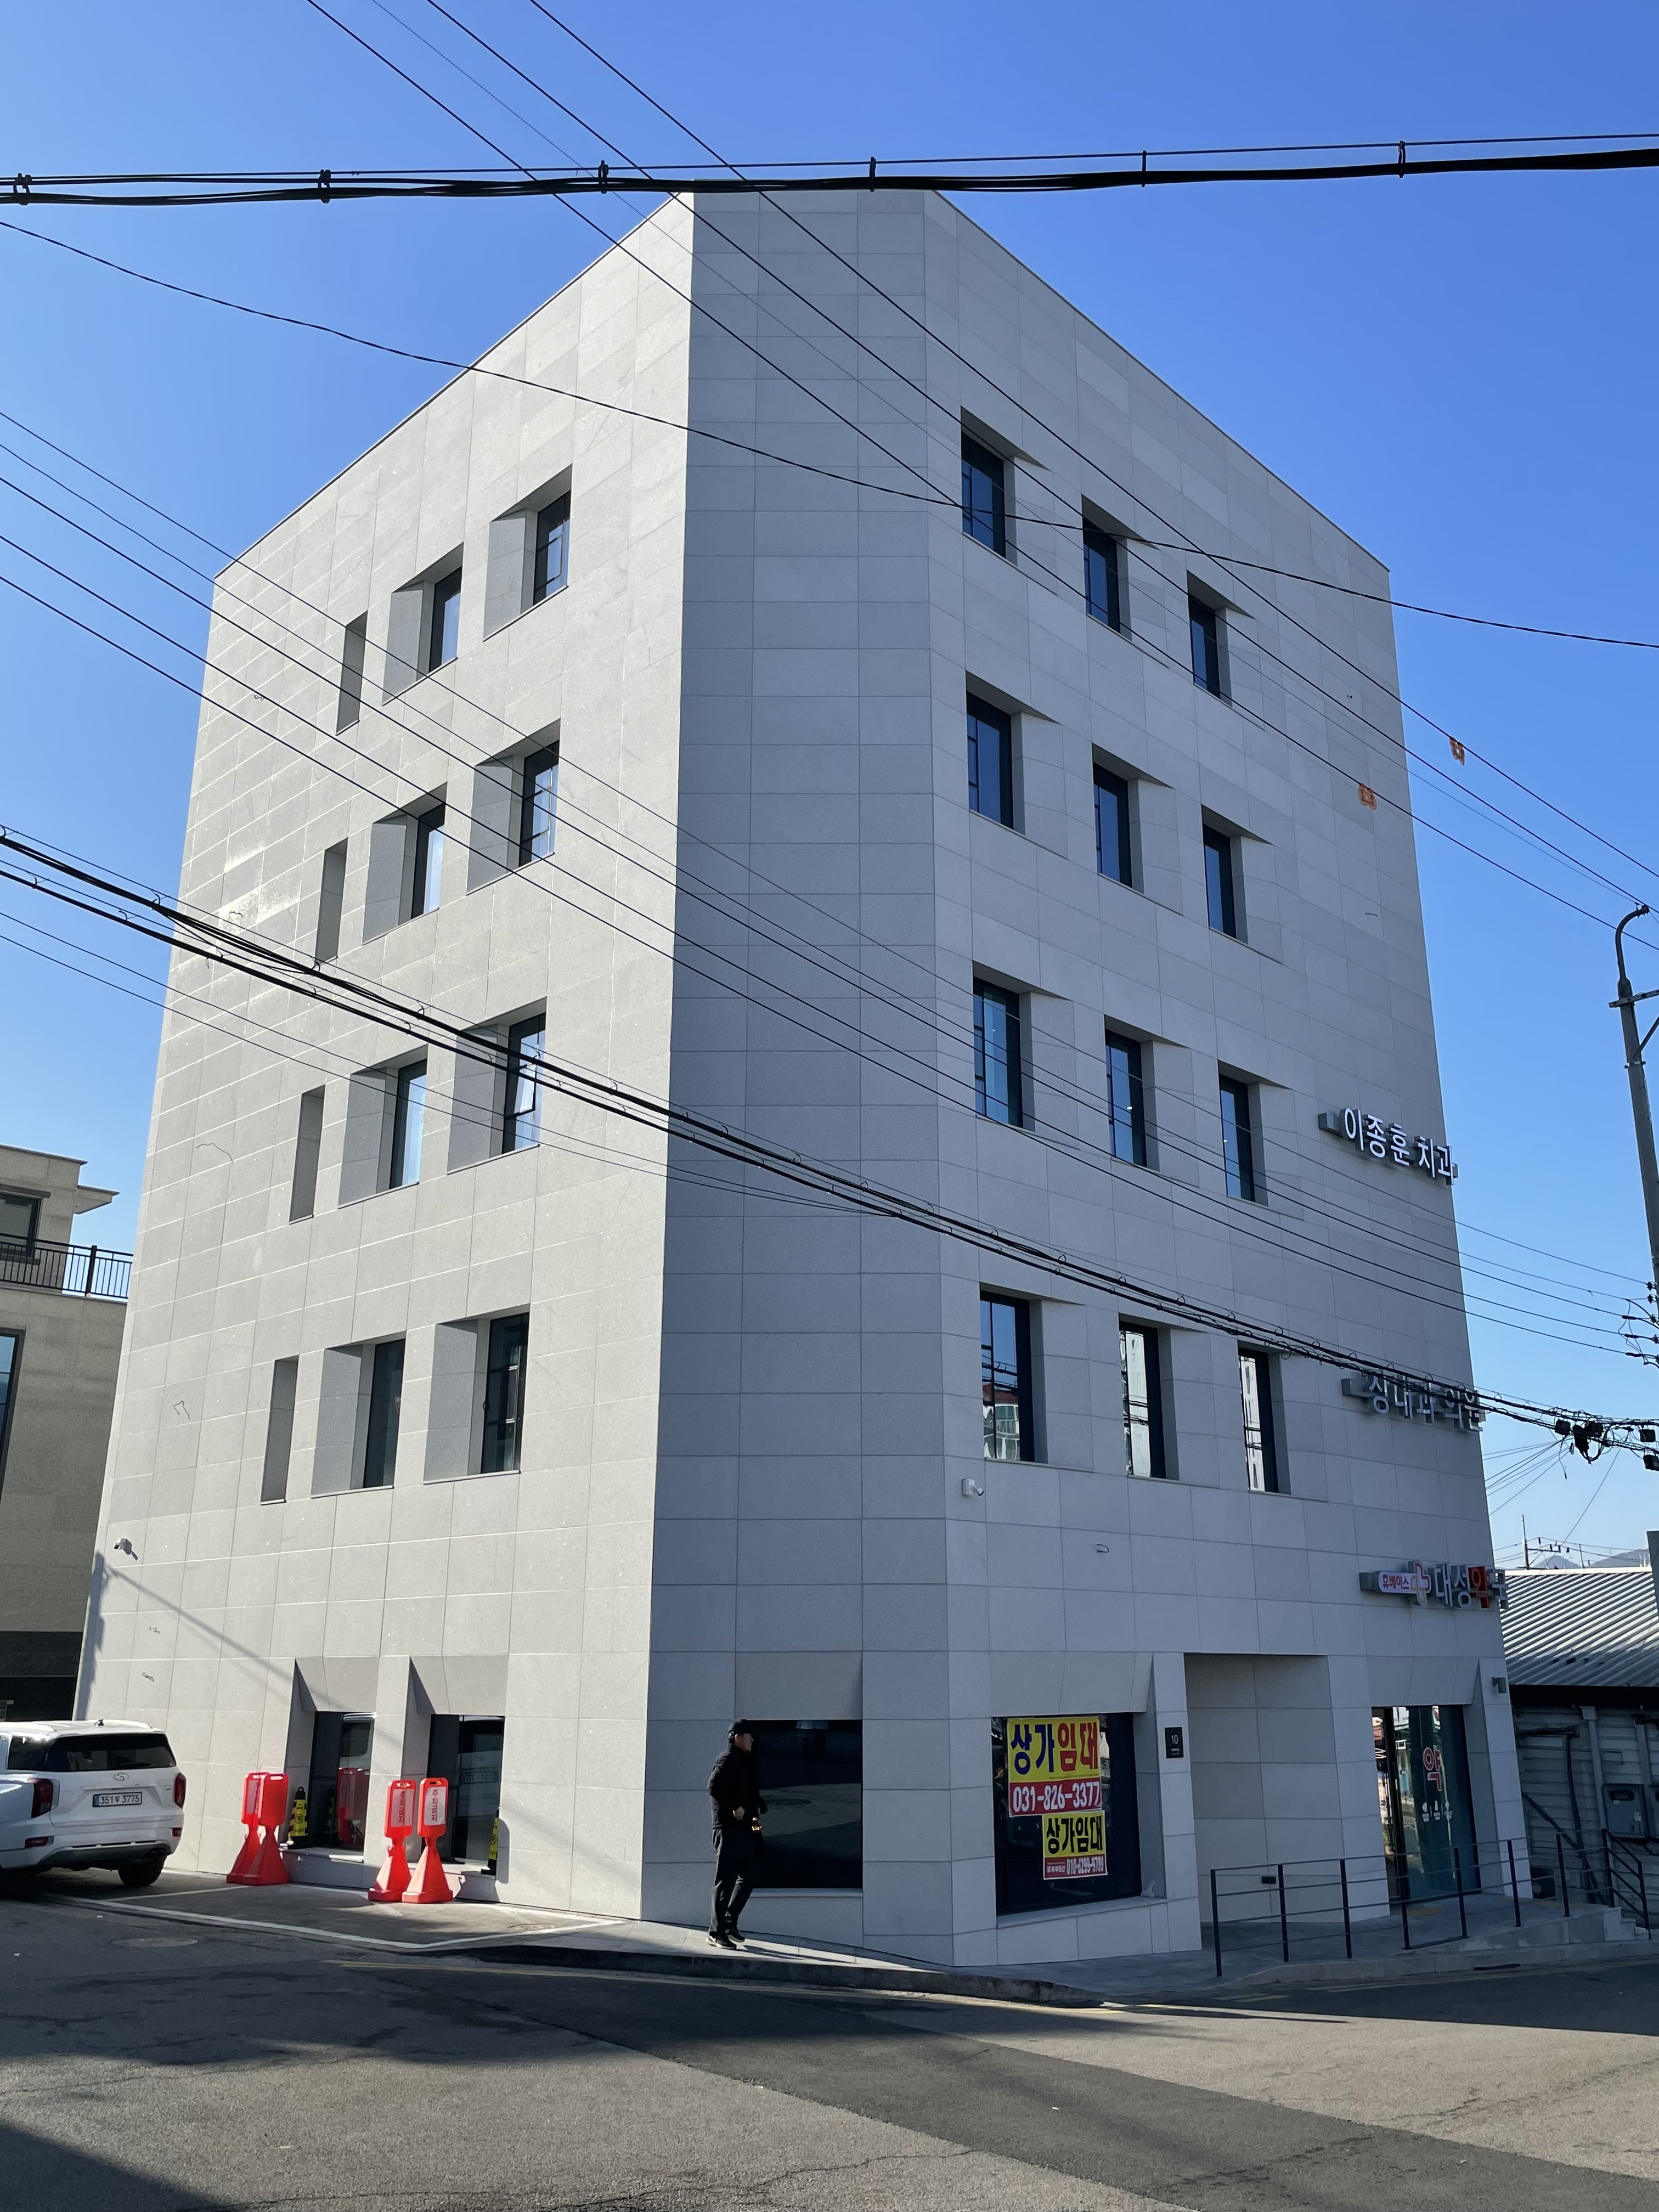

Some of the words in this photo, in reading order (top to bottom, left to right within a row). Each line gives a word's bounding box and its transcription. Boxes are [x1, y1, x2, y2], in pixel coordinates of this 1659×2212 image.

[1383, 1574, 1409, 1589] 휴베이스
[1011, 1722, 1098, 1775] 상가임대
[1171, 1735, 1178, 1744] 10
[121, 1795, 139, 1803] 3775
[1013, 1781, 1100, 1812] 031-826-3377
[1046, 1816, 1103, 1854] 상가임대
